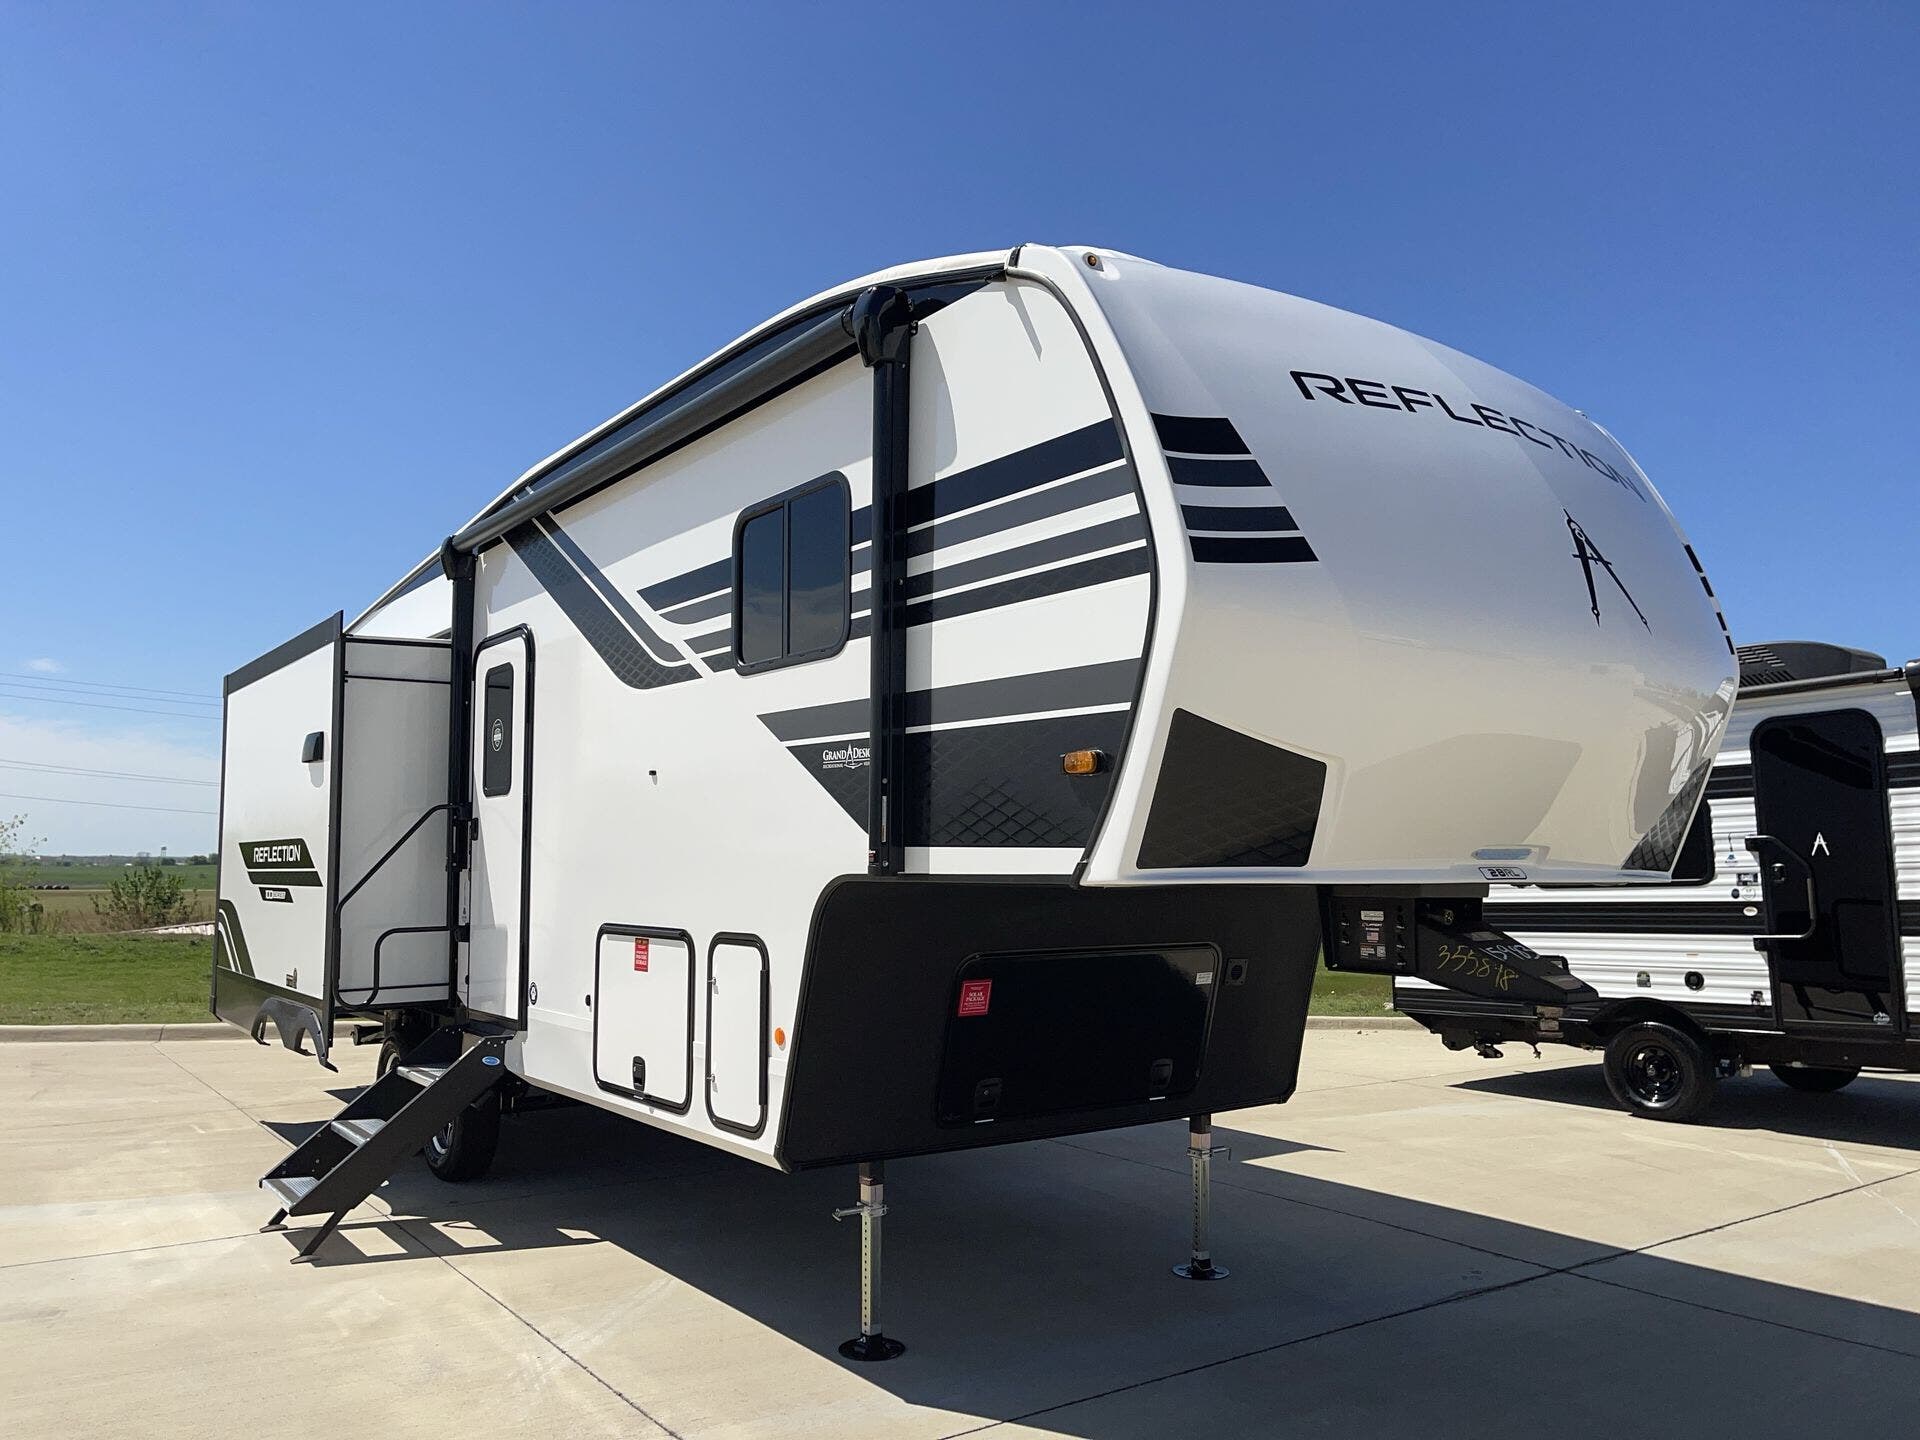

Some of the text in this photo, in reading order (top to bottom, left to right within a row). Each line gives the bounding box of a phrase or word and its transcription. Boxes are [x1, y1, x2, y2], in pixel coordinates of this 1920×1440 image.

[1290, 370, 1647, 503] REFLECTION
[822, 749, 847, 760] GRAND
[253, 844, 301, 862] REFLECTION
